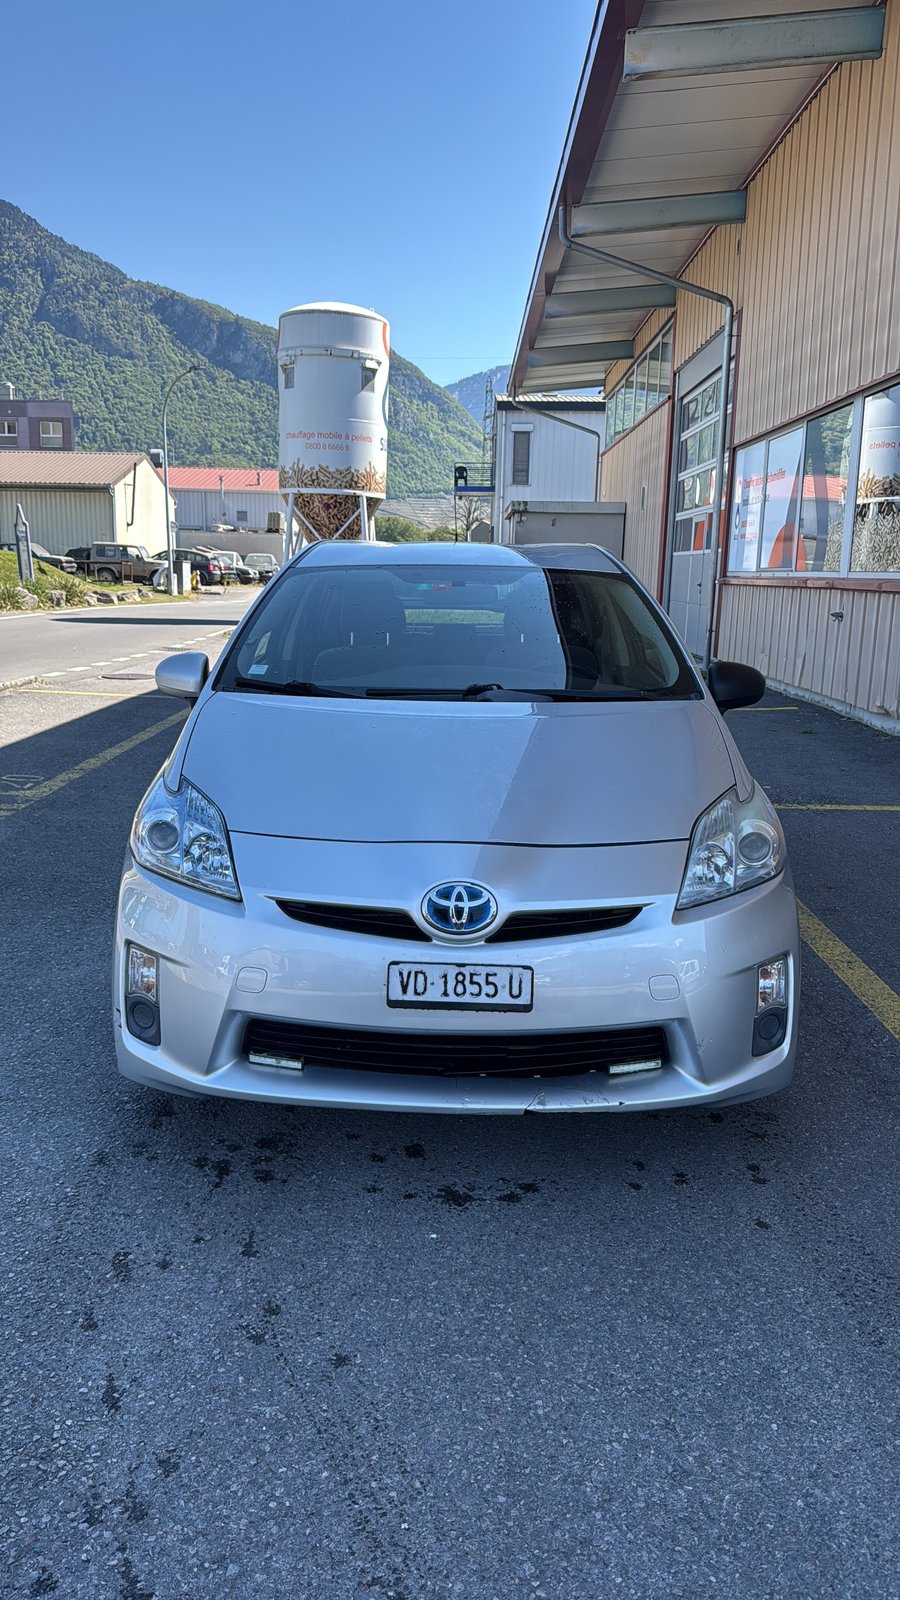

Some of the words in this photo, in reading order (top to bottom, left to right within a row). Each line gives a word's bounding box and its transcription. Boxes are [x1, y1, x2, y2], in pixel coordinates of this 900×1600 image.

[286, 431, 315, 440] chauffage
[317, 431, 342, 440] mobile
[345, 432, 350, 441] à
[351, 434, 372, 443] pellets
[305, 442, 321, 450] 0800
[398, 970, 428, 996] VD
[440, 971, 499, 998] 1855
[508, 972, 523, 999] U
